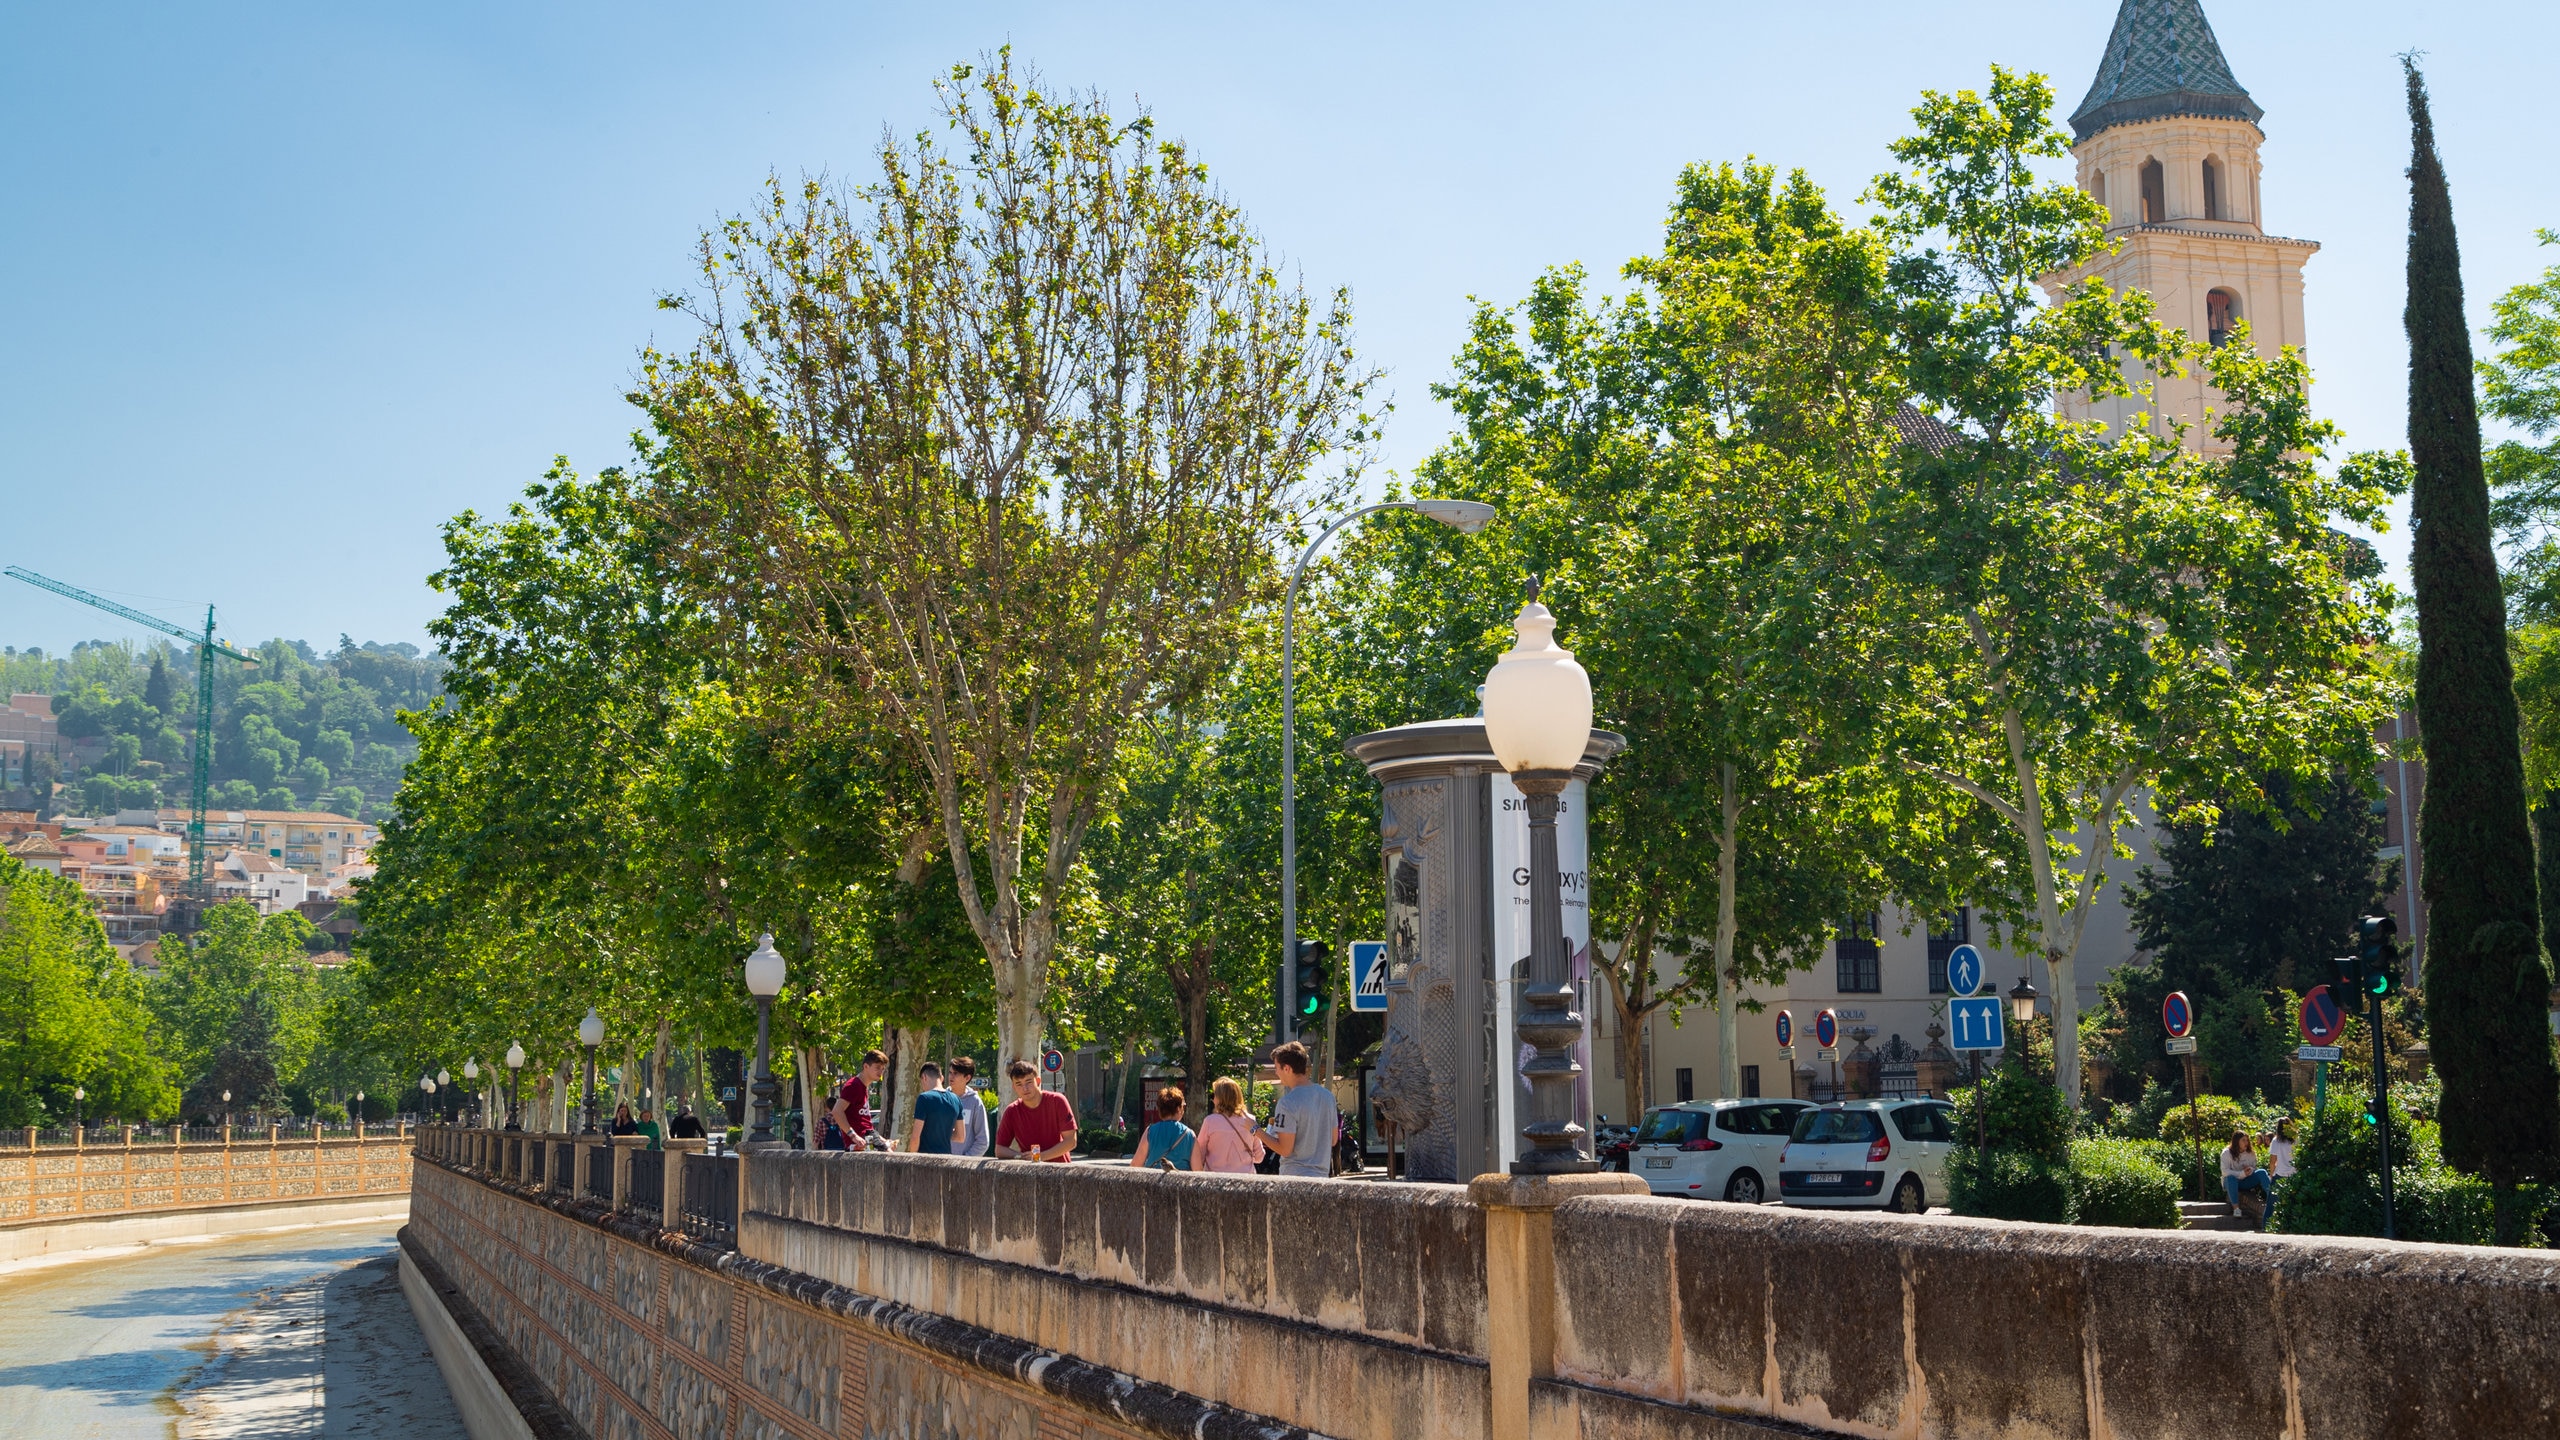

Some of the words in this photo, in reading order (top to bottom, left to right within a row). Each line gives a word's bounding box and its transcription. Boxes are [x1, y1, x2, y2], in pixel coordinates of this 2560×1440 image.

[1514, 897, 1529, 905] The
[2299, 1047, 2316, 1057] ENTRADA
[2317, 1048, 2339, 1058] URGENCIAS
